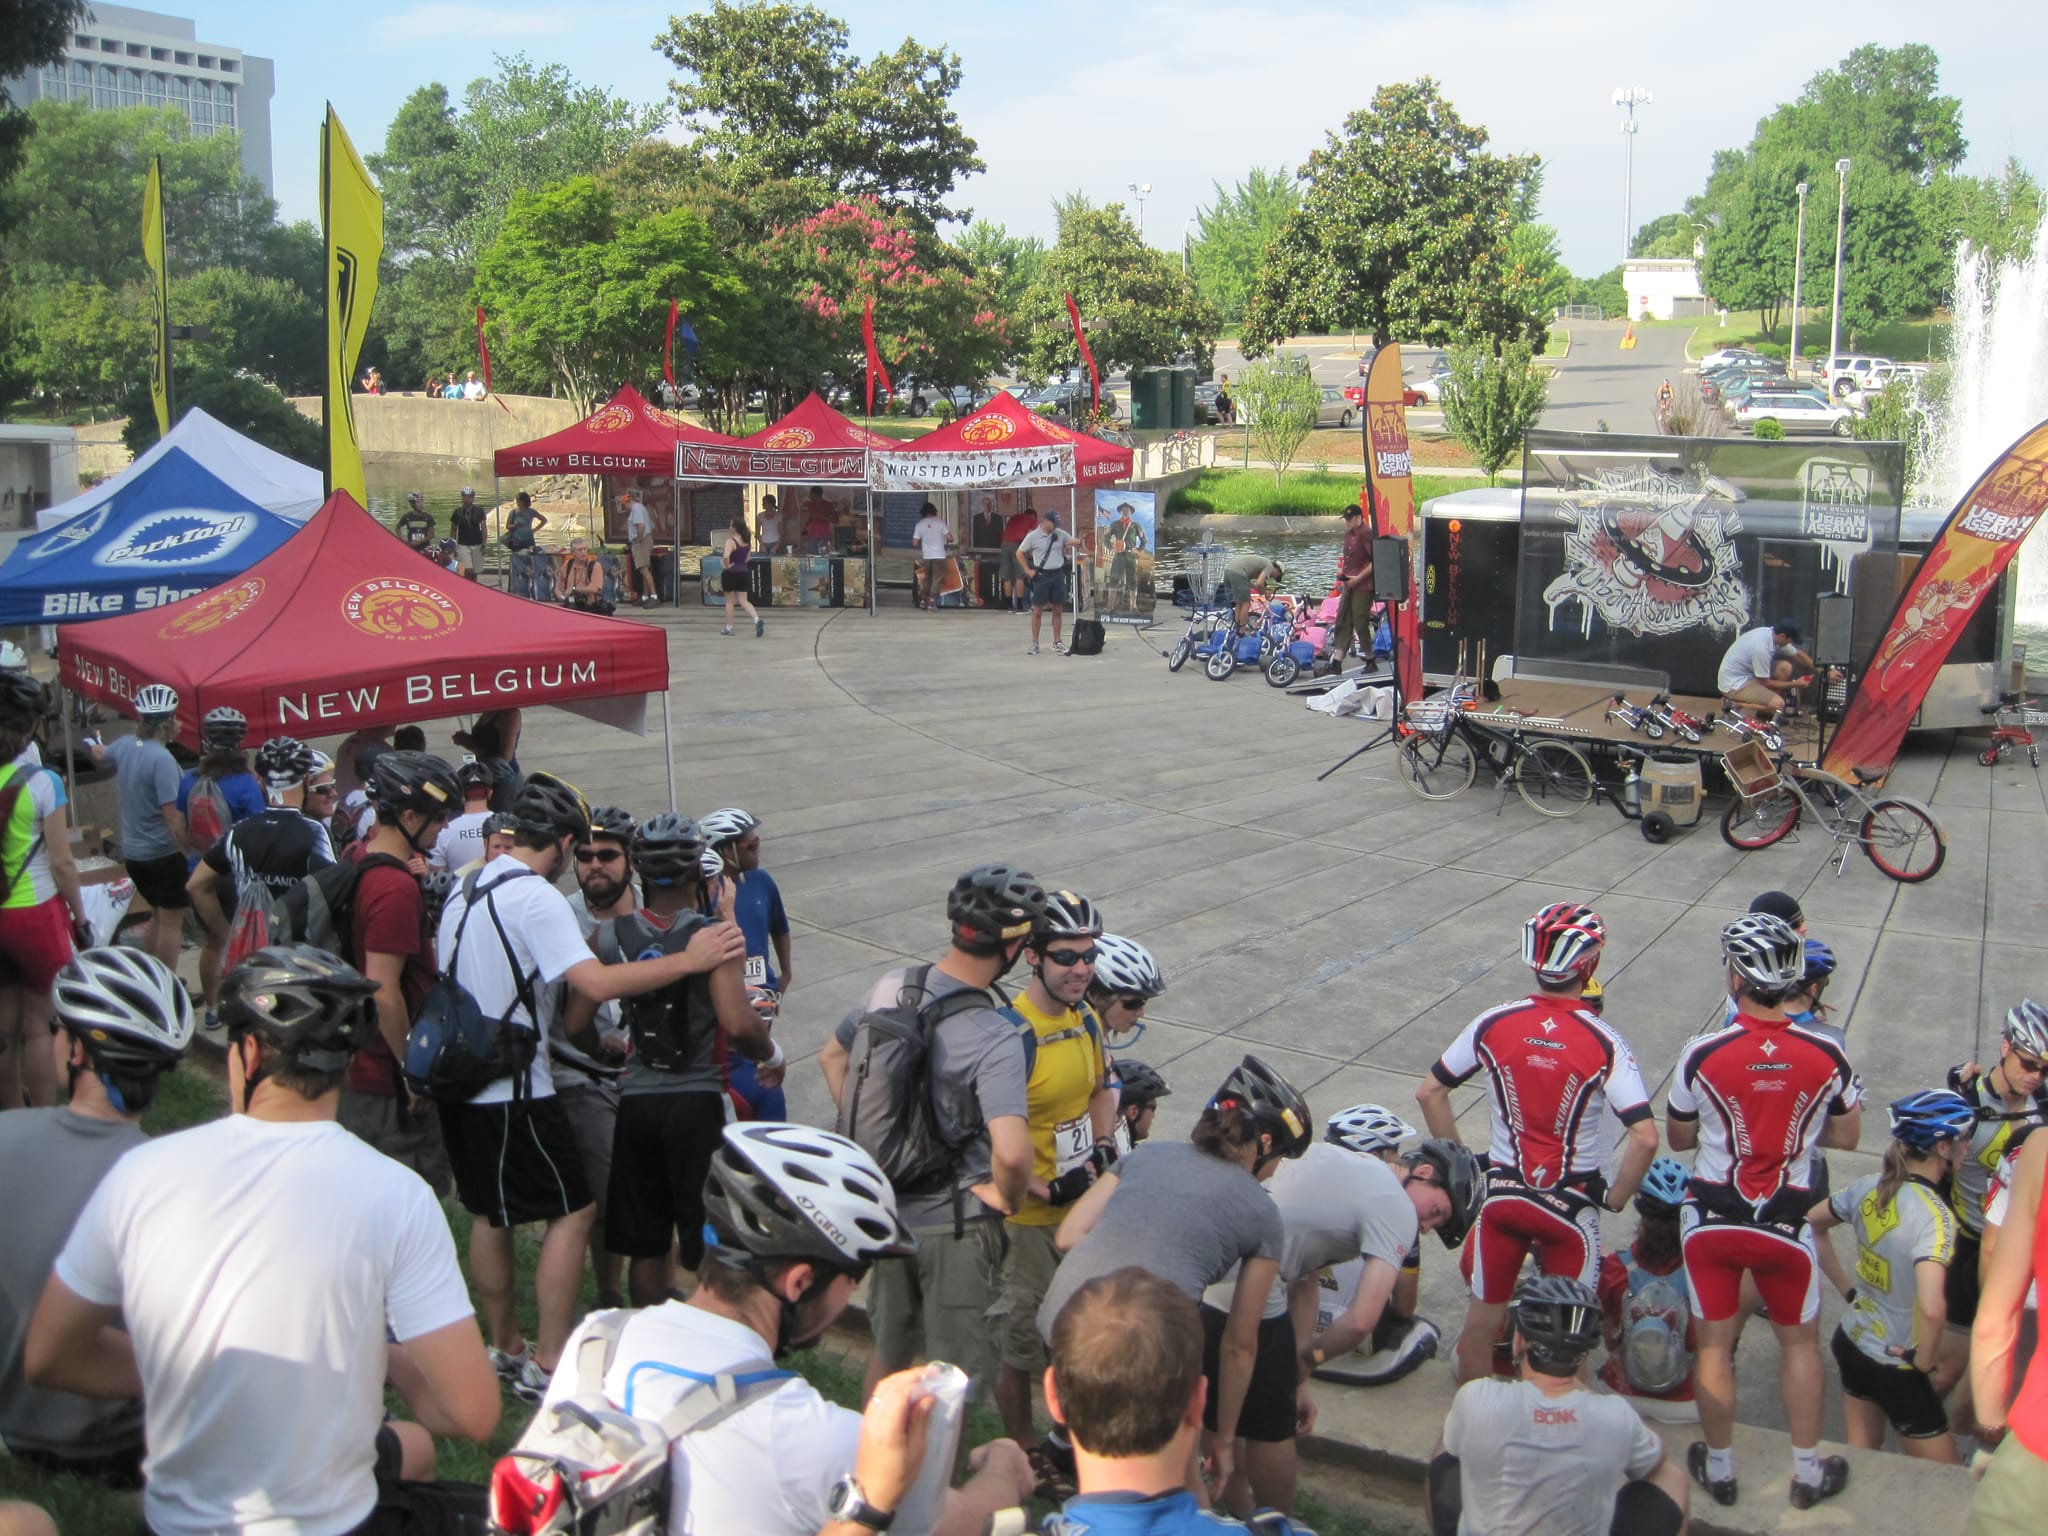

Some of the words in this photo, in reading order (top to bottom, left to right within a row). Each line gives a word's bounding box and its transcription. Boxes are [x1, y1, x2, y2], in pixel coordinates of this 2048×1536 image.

[522, 456, 560, 468] NEW
[568, 454, 646, 469] BELGIUM
[684, 447, 743, 470] NEW
[749, 453, 864, 475] BELGIUM
[887, 463, 987, 479] WRISTBAND
[999, 457, 1059, 477] CAMP
[1082, 464, 1097, 477] NEW
[1098, 462, 1125, 475] BELGIUM
[1807, 521, 1865, 539] ASSAULT
[1809, 512, 1866, 528] URBAN
[1968, 504, 2035, 529] URBAN
[43, 591, 123, 617] Bike
[347, 592, 364, 620] NEW
[365, 580, 452, 609] BELGIUM
[75, 653, 104, 688] NEW
[279, 685, 381, 724] NEW
[406, 660, 597, 705] BELGIUM
[1502, 1065, 1525, 1133] SPECIALIZED
[1553, 1073, 1579, 1136] SPECIALIZED
[1727, 1095, 1753, 1157] SPECIALIZED
[1783, 1090, 1809, 1156] SPECIALIZED
[1072, 1124, 1089, 1153] 21
[812, 1210, 848, 1246] GIRO
[1532, 1407, 1579, 1425] BONK
